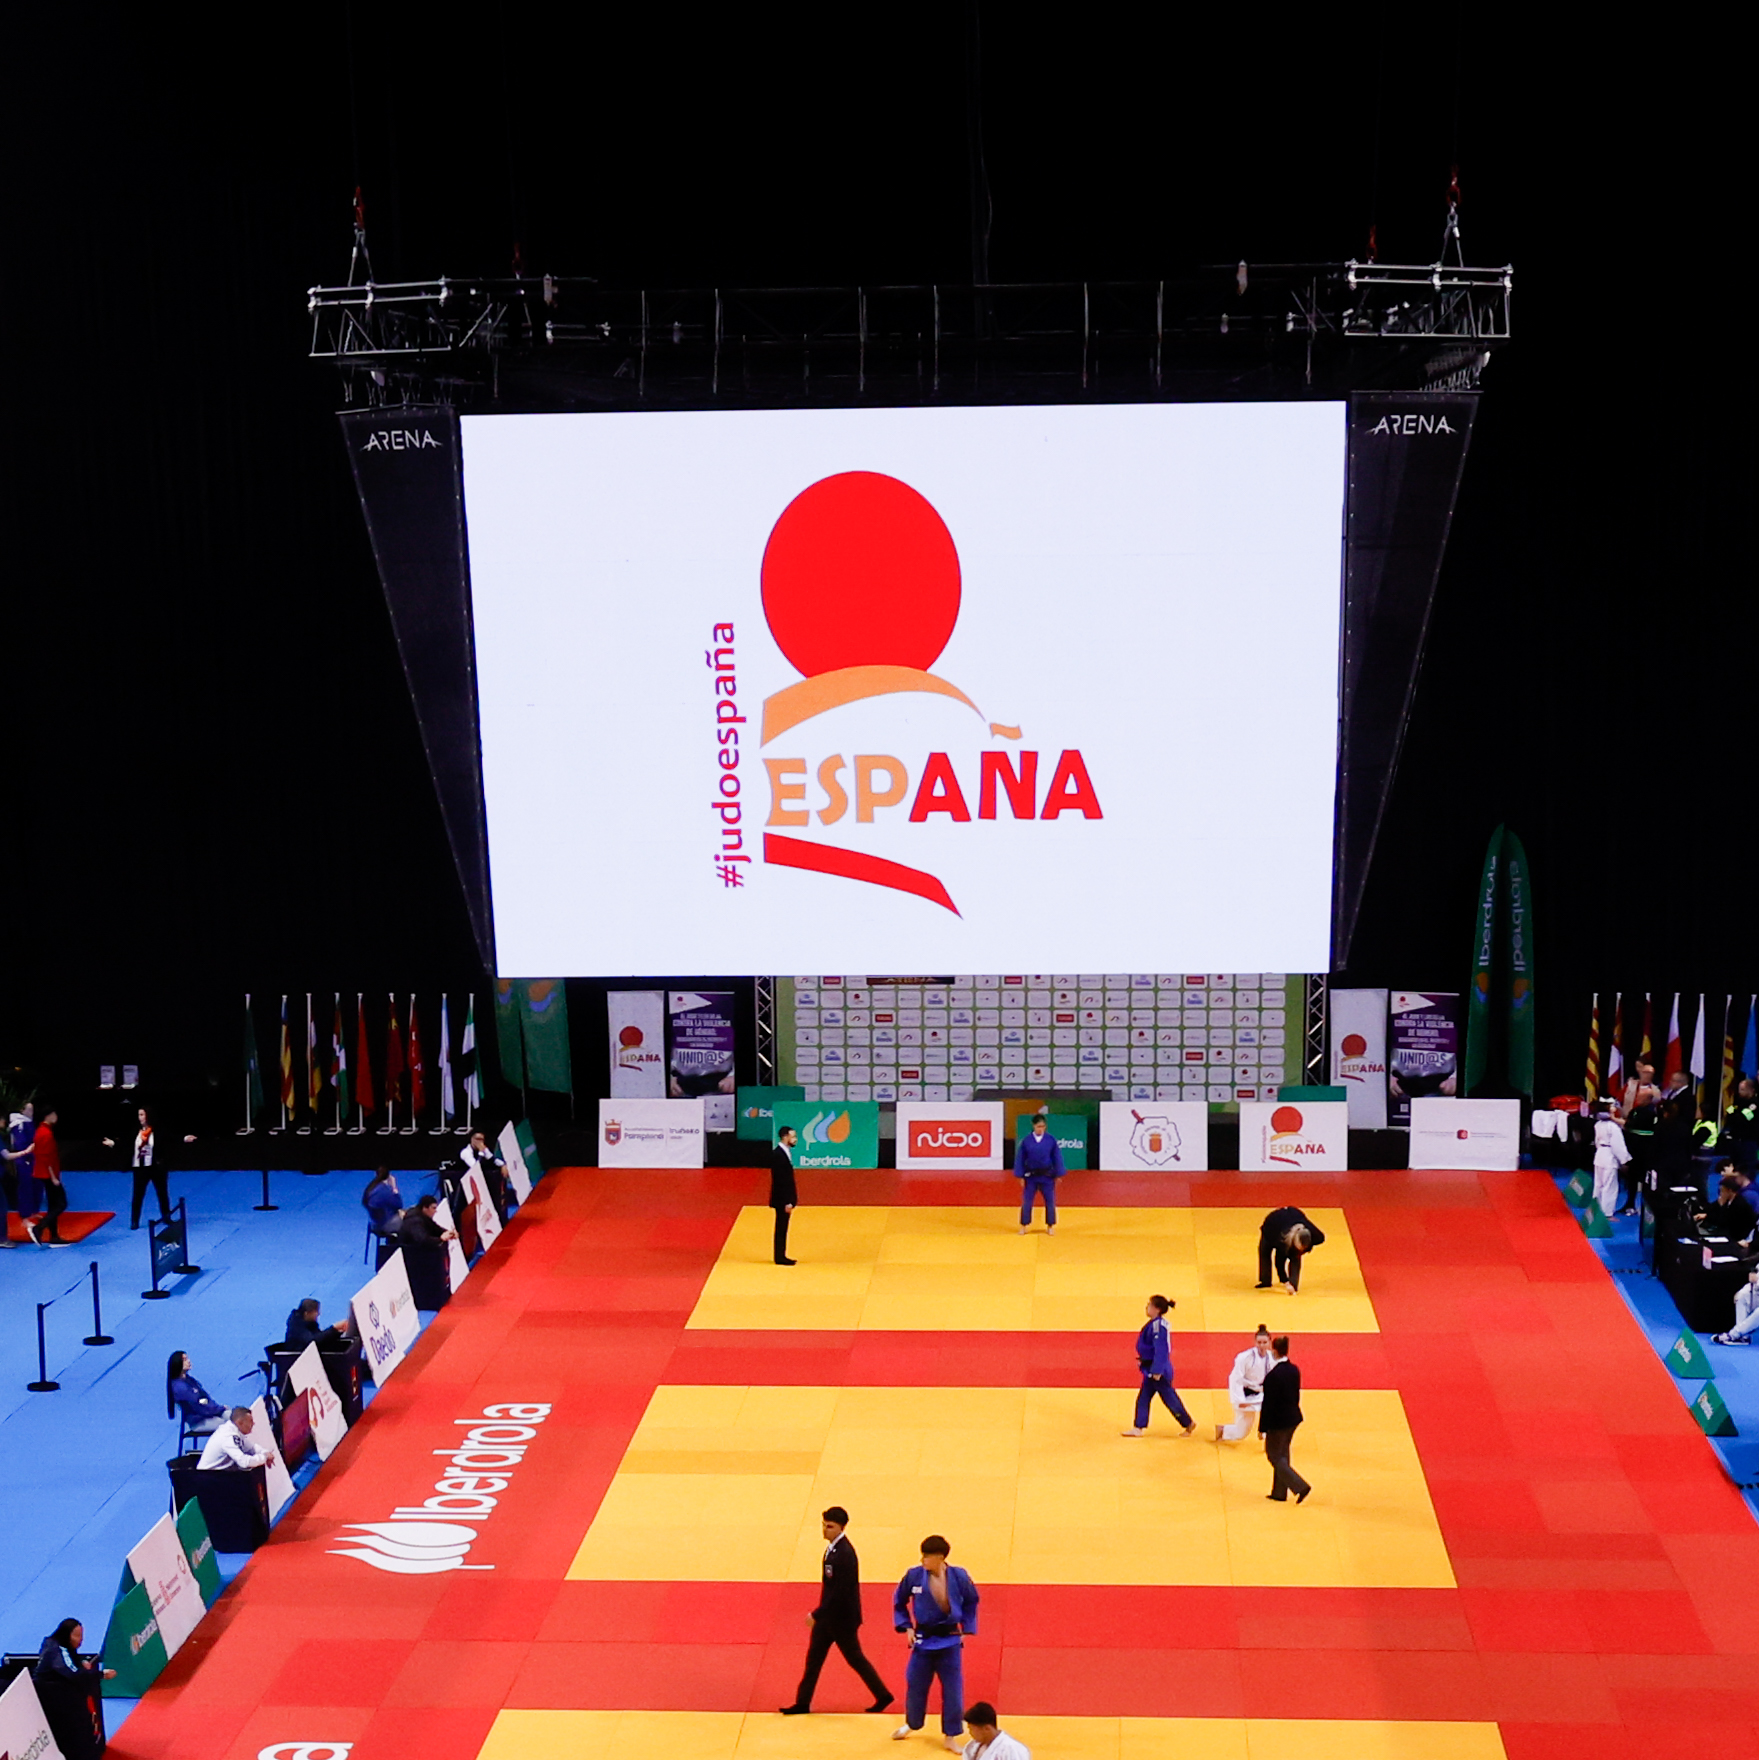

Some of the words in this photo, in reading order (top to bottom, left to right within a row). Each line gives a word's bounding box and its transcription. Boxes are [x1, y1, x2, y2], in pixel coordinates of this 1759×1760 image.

[1365, 414, 1457, 435] ARENA
[361, 429, 442, 451] ARENA
[706, 622, 751, 888] #judoespaña
[762, 722, 1104, 827] ESPAÑA
[1270, 1139, 1326, 1155] ESPAÑA
[799, 1155, 852, 1167] Iberdrola
[389, 1403, 552, 1520] Iberdrola
